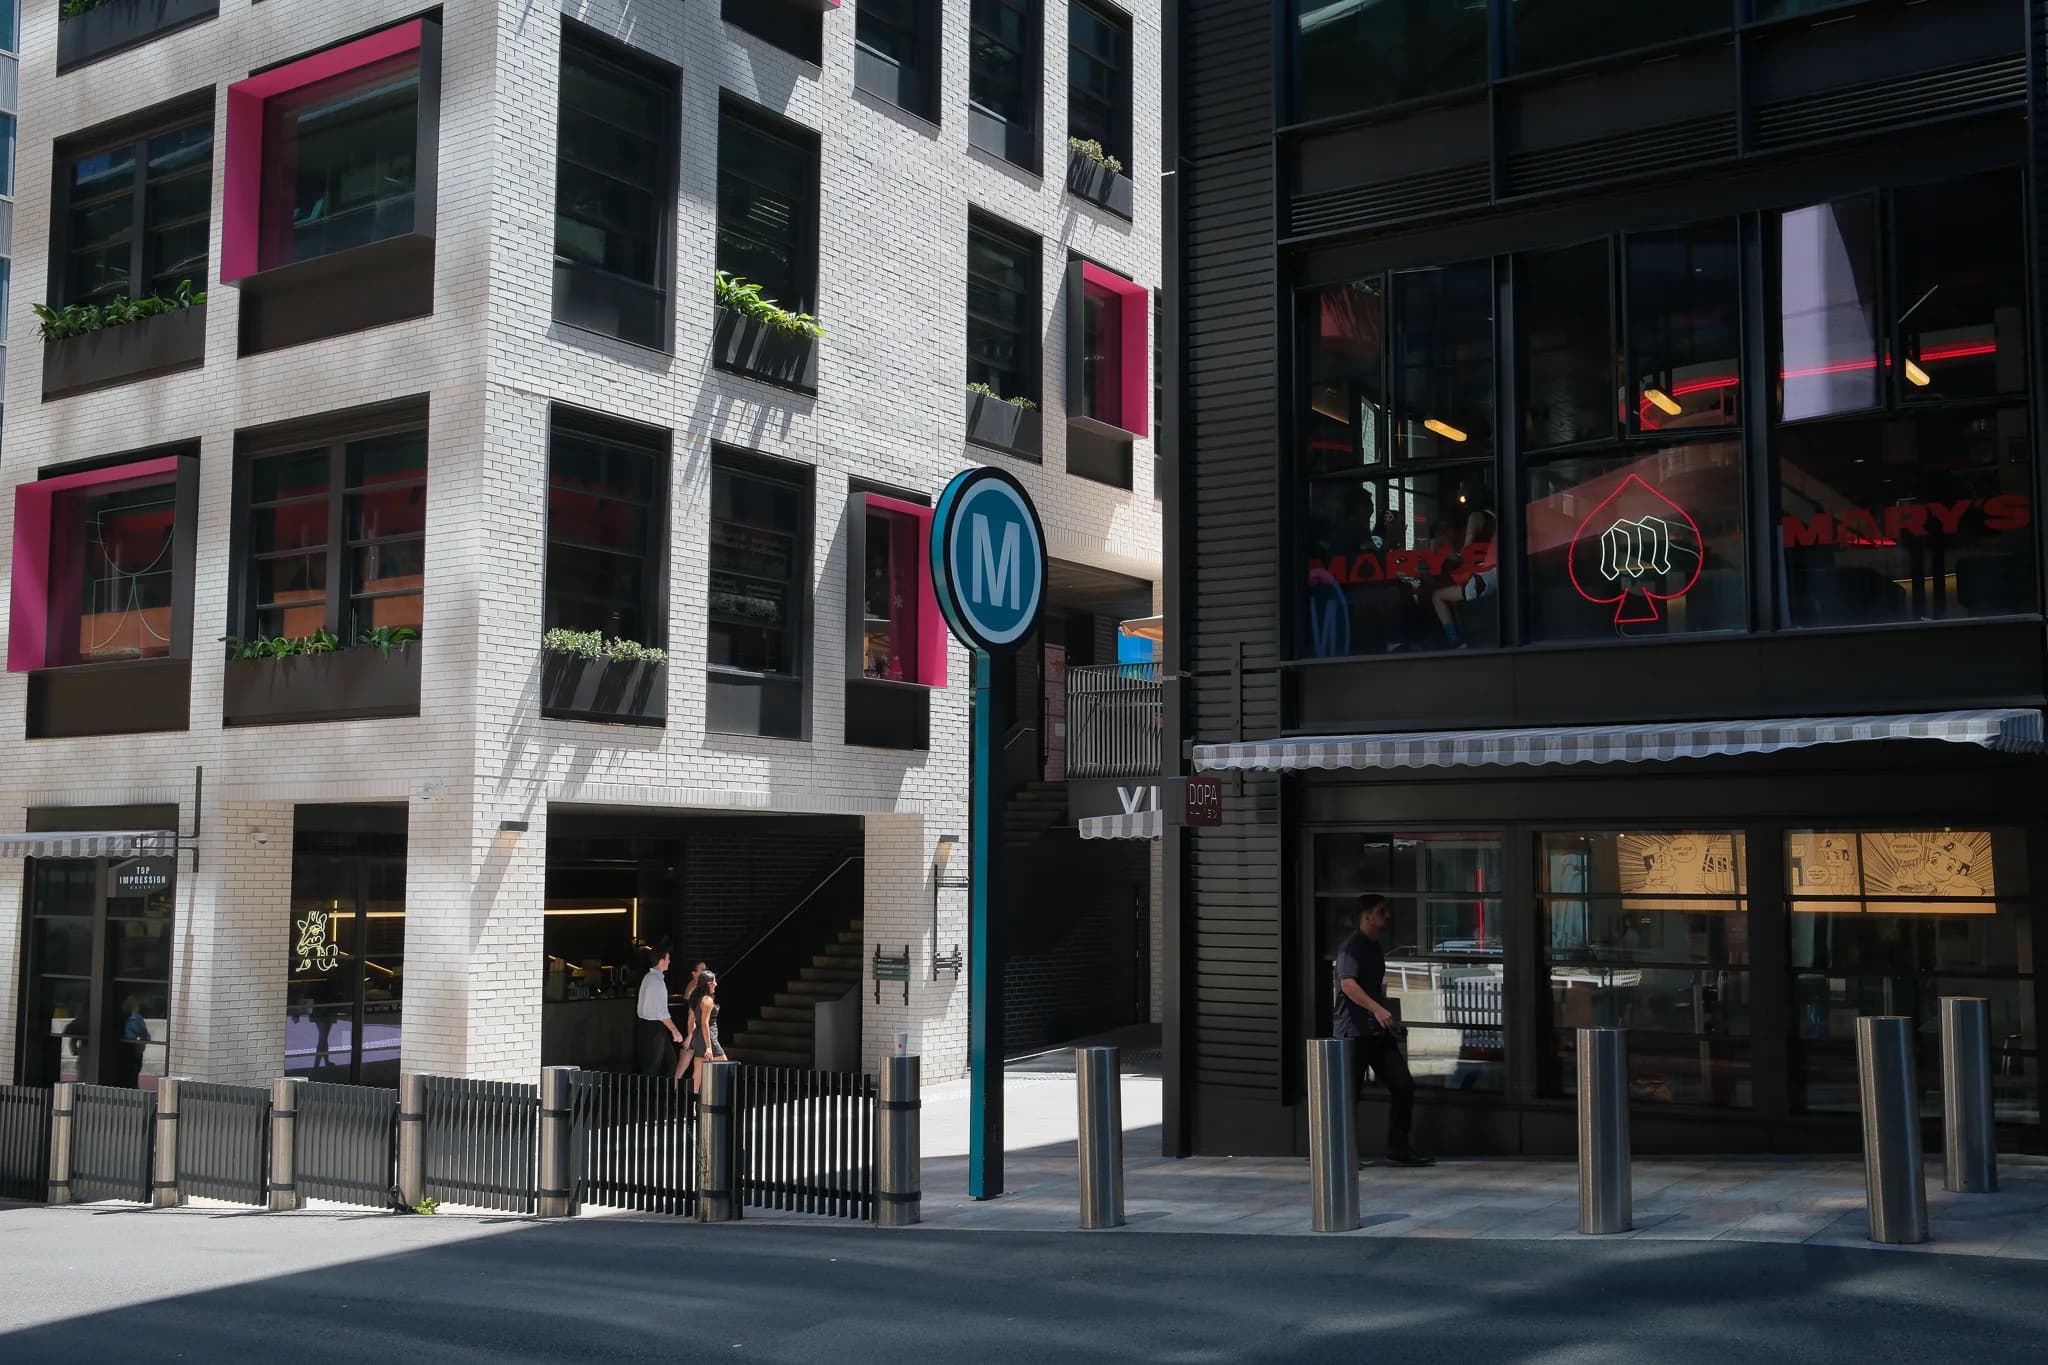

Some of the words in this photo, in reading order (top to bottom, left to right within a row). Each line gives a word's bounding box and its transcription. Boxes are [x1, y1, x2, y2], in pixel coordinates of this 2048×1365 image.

[1780, 493, 2031, 548] MARY'S
[972, 512, 1021, 611] M
[1189, 783, 1218, 806] DOPA
[119, 875, 166, 885] IMPRESSION
[136, 866, 150, 875] TOP
